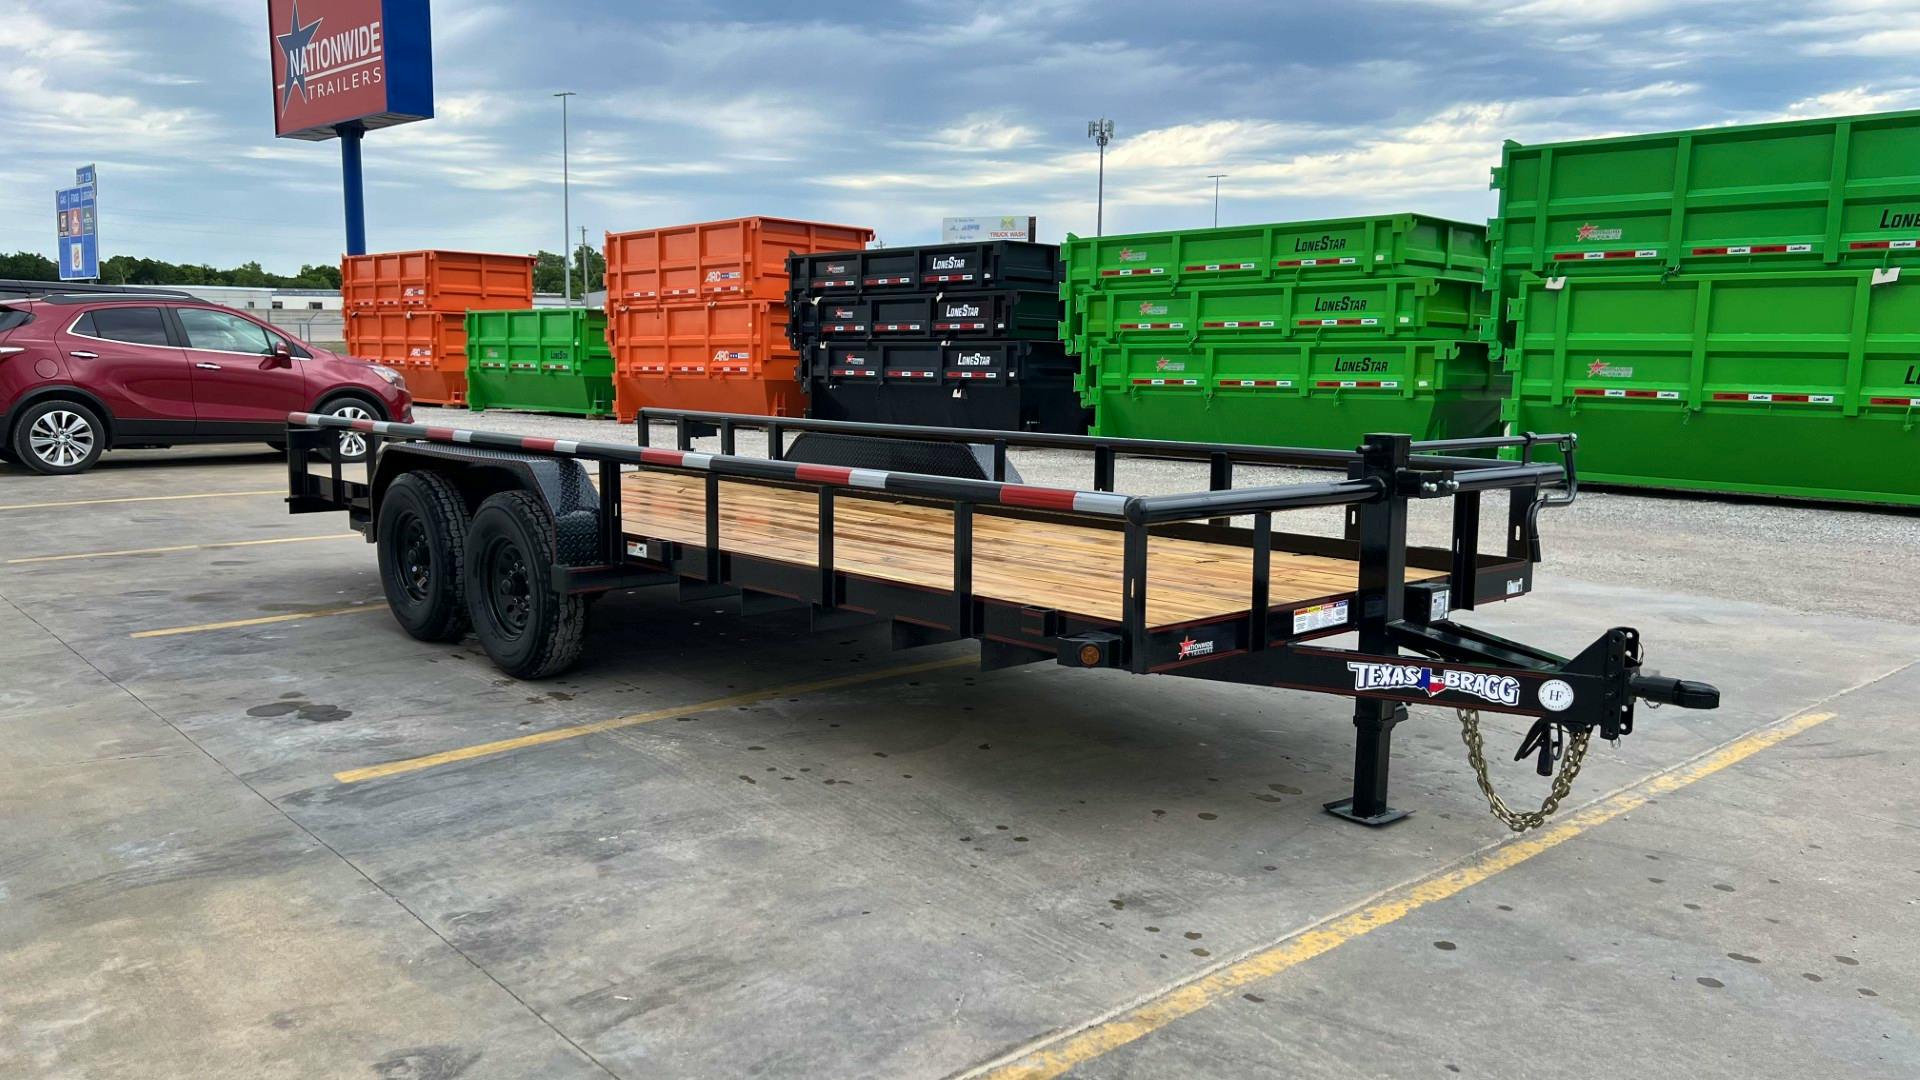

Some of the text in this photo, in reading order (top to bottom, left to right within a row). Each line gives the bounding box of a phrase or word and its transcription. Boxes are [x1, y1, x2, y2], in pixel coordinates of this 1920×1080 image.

[290, 21, 381, 78] NATIONWIDE
[307, 67, 381, 100] TRAILERS
[1348, 662, 1421, 690] TEXAS
[1444, 670, 1520, 706] BRAGG
